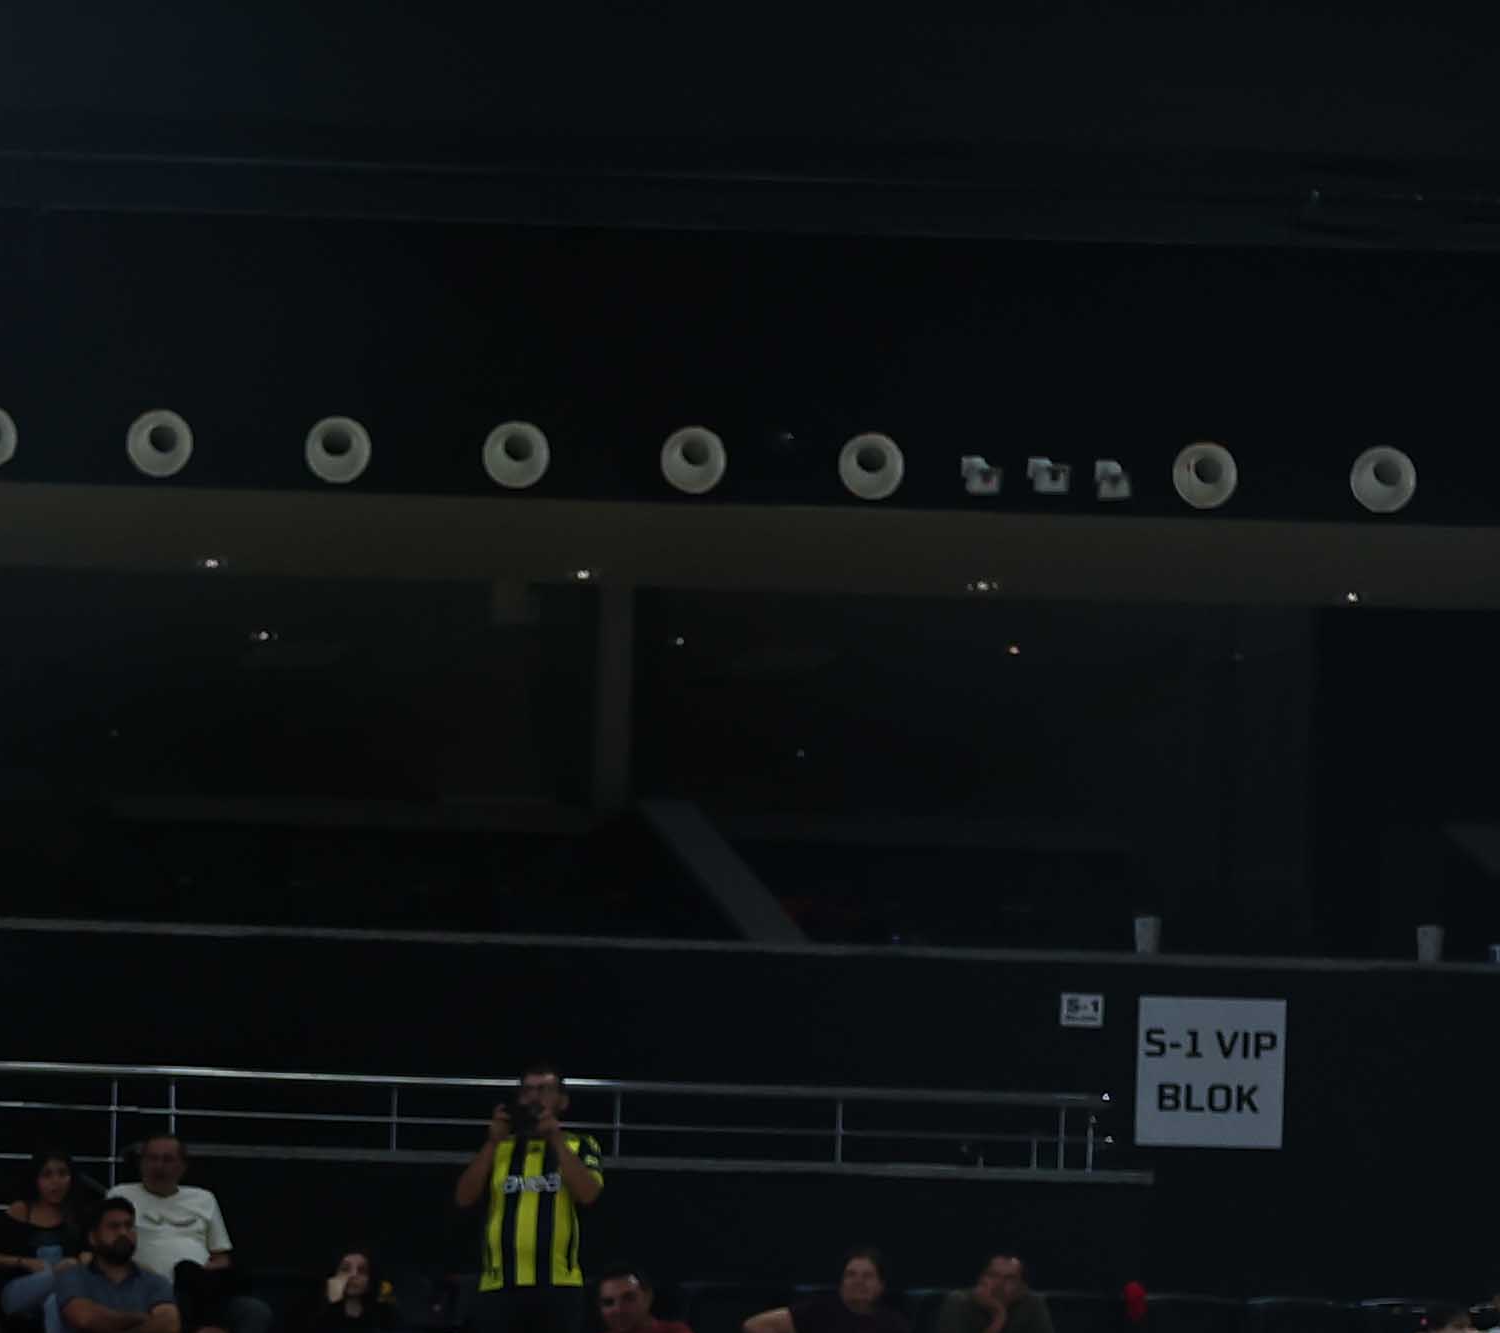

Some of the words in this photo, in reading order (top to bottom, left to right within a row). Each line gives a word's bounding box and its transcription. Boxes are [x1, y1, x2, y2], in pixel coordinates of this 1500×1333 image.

[1145, 1028, 1203, 1058] S-1
[1216, 1030, 1278, 1059] VIP
[1158, 1083, 1260, 1114] BLOK
